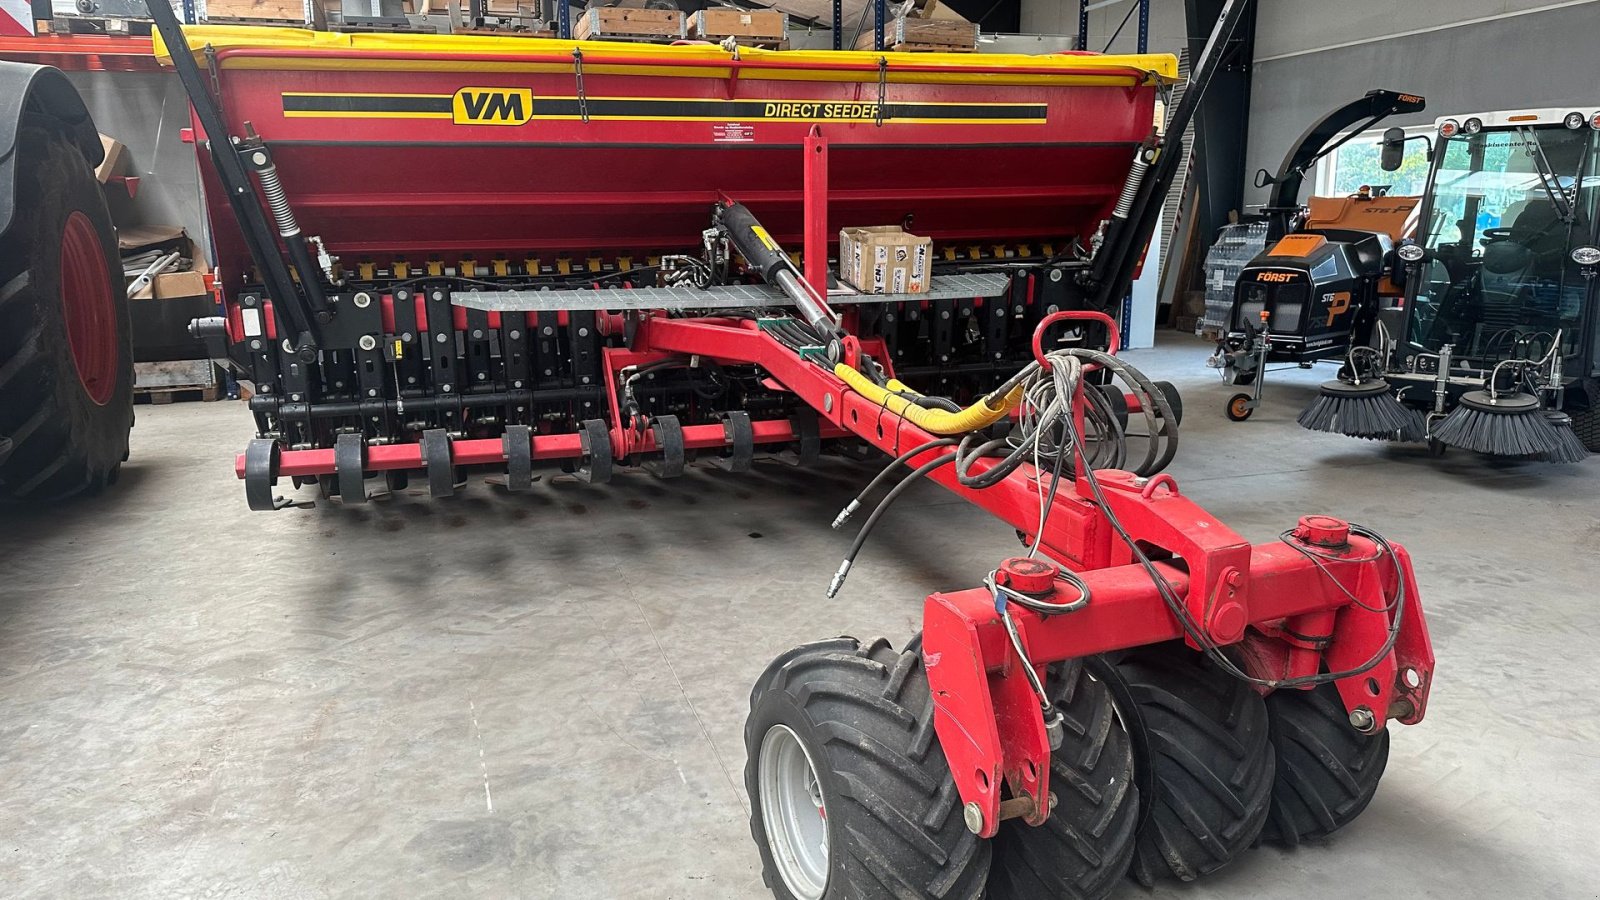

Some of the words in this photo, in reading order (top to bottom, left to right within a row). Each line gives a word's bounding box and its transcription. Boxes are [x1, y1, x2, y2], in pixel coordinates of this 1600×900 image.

[461, 92, 524, 120] VM
[765, 103, 821, 117] DIRECT
[1256, 271, 1298, 282] FÖRST
